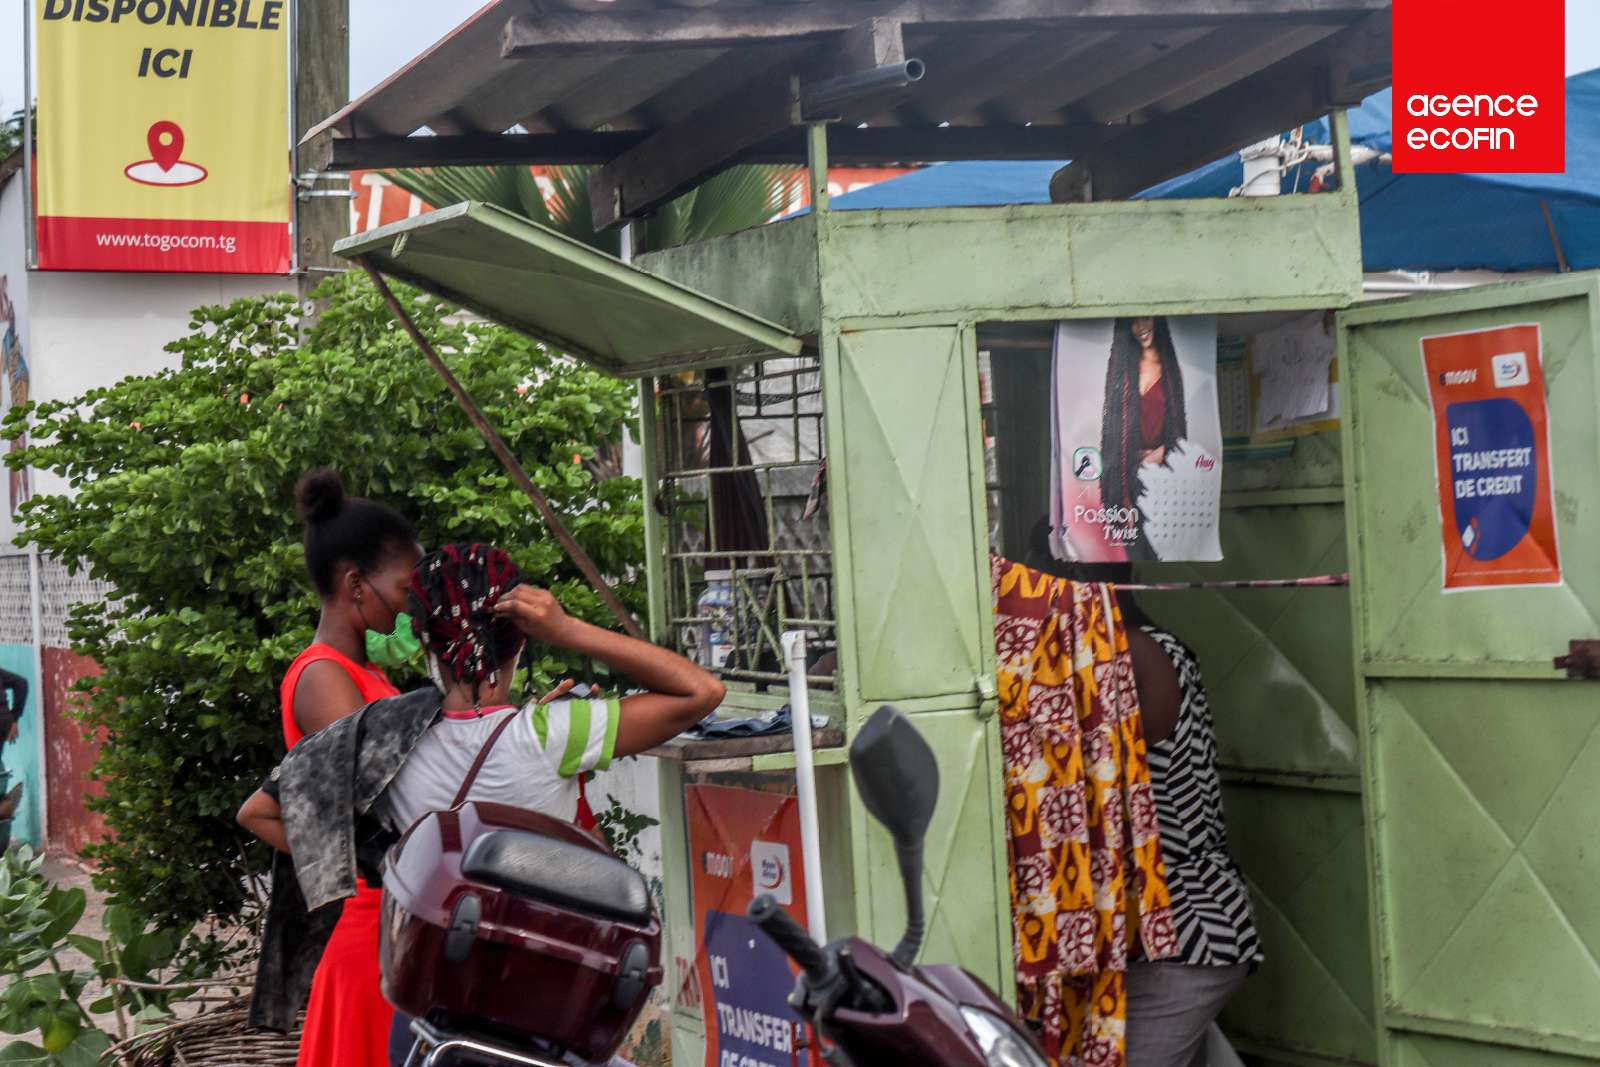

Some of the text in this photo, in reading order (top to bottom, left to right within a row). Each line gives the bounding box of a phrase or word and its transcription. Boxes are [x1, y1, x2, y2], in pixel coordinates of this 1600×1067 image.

[43, 0, 283, 30] DISPONIBLE
[138, 48, 193, 79] ICI
[96, 233, 237, 253] www.togocom.tg
[1451, 427, 1469, 446] ICI
[1453, 447, 1532, 472] TRANSFERT
[1455, 475, 1523, 499] DE CREDIT
[1074, 503, 1139, 523] Passion
[1103, 524, 1139, 540] Twist
[710, 954, 730, 989] ICI
